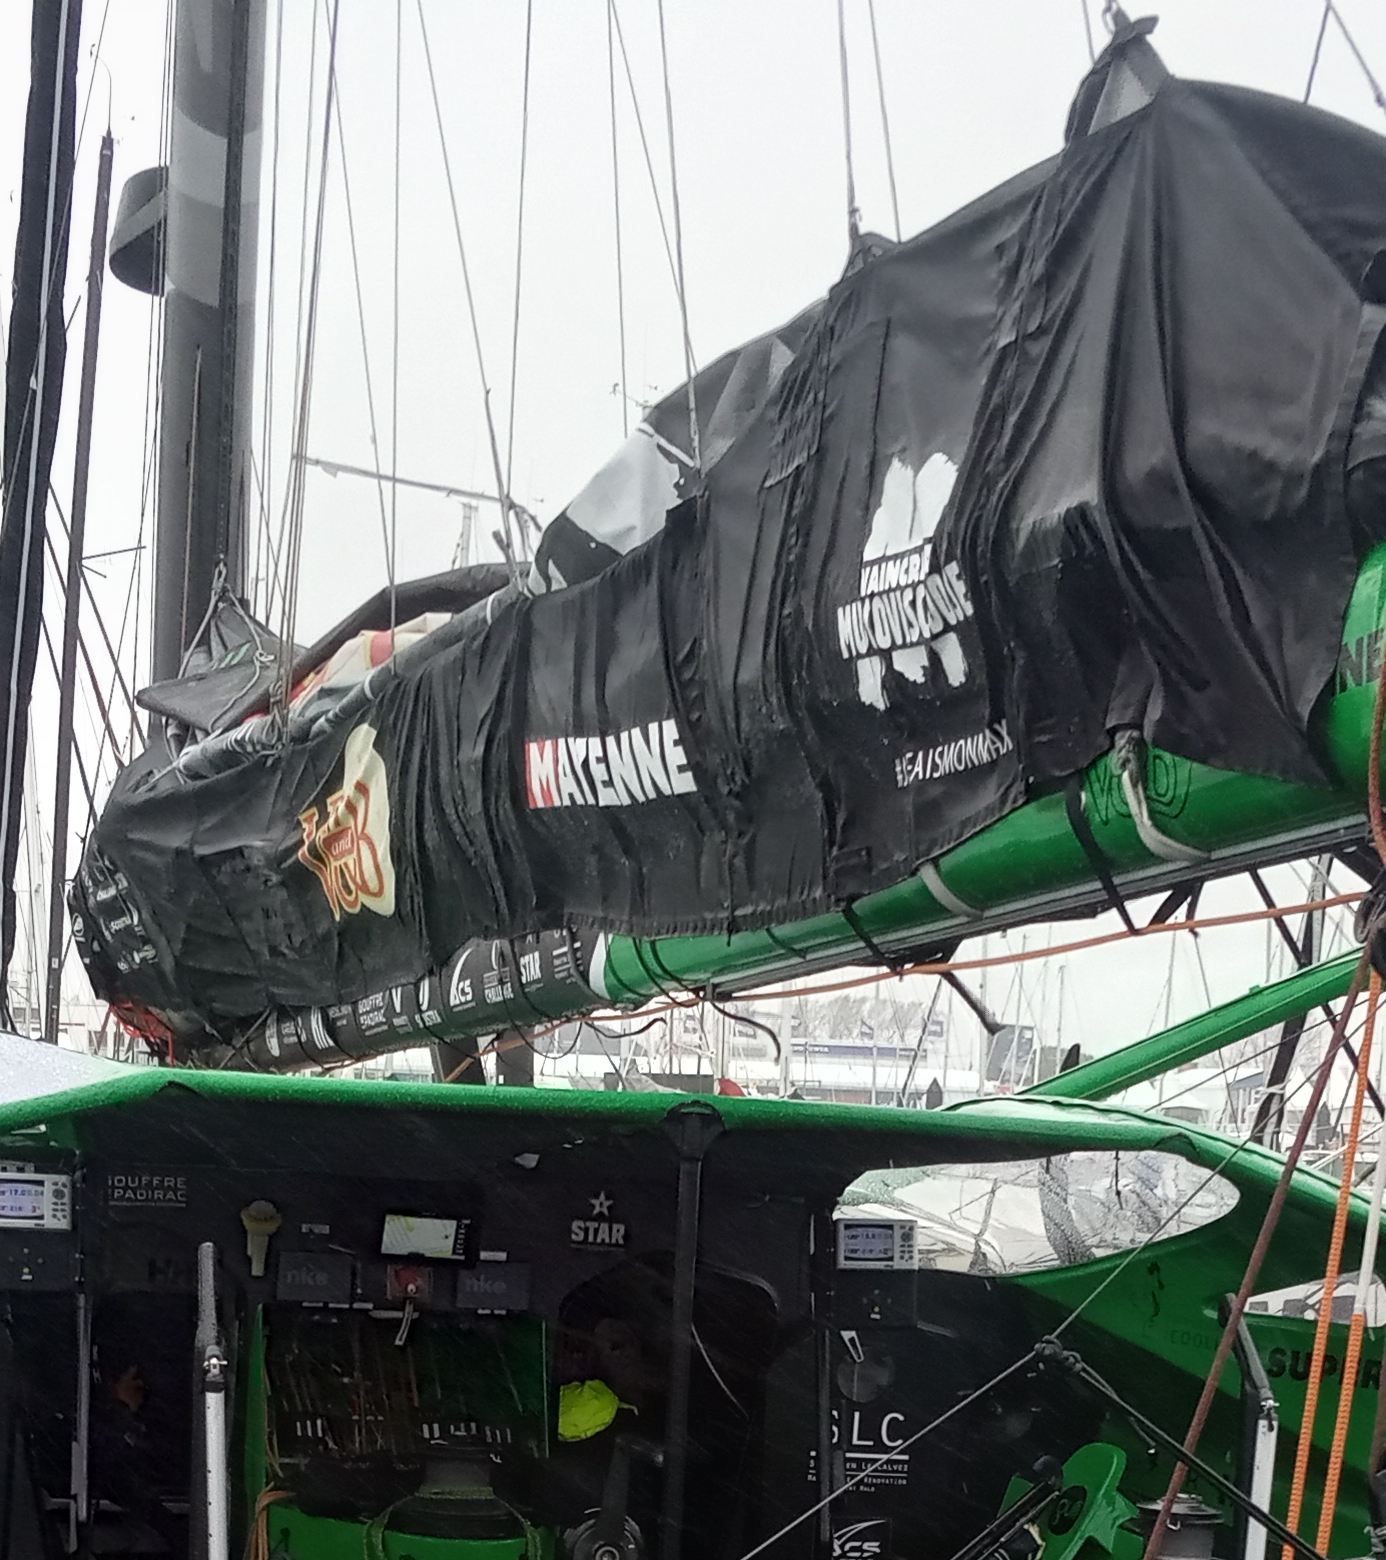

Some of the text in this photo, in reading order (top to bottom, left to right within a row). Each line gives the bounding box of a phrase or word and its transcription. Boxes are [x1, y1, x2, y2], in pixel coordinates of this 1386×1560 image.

[525, 719, 698, 808] MAYENNE
[330, 830, 354, 857] and
[108, 1175, 187, 1189] OUFFRE
[570, 1218, 627, 1247] STAR
[1267, 1347, 1382, 1390] SUPR
